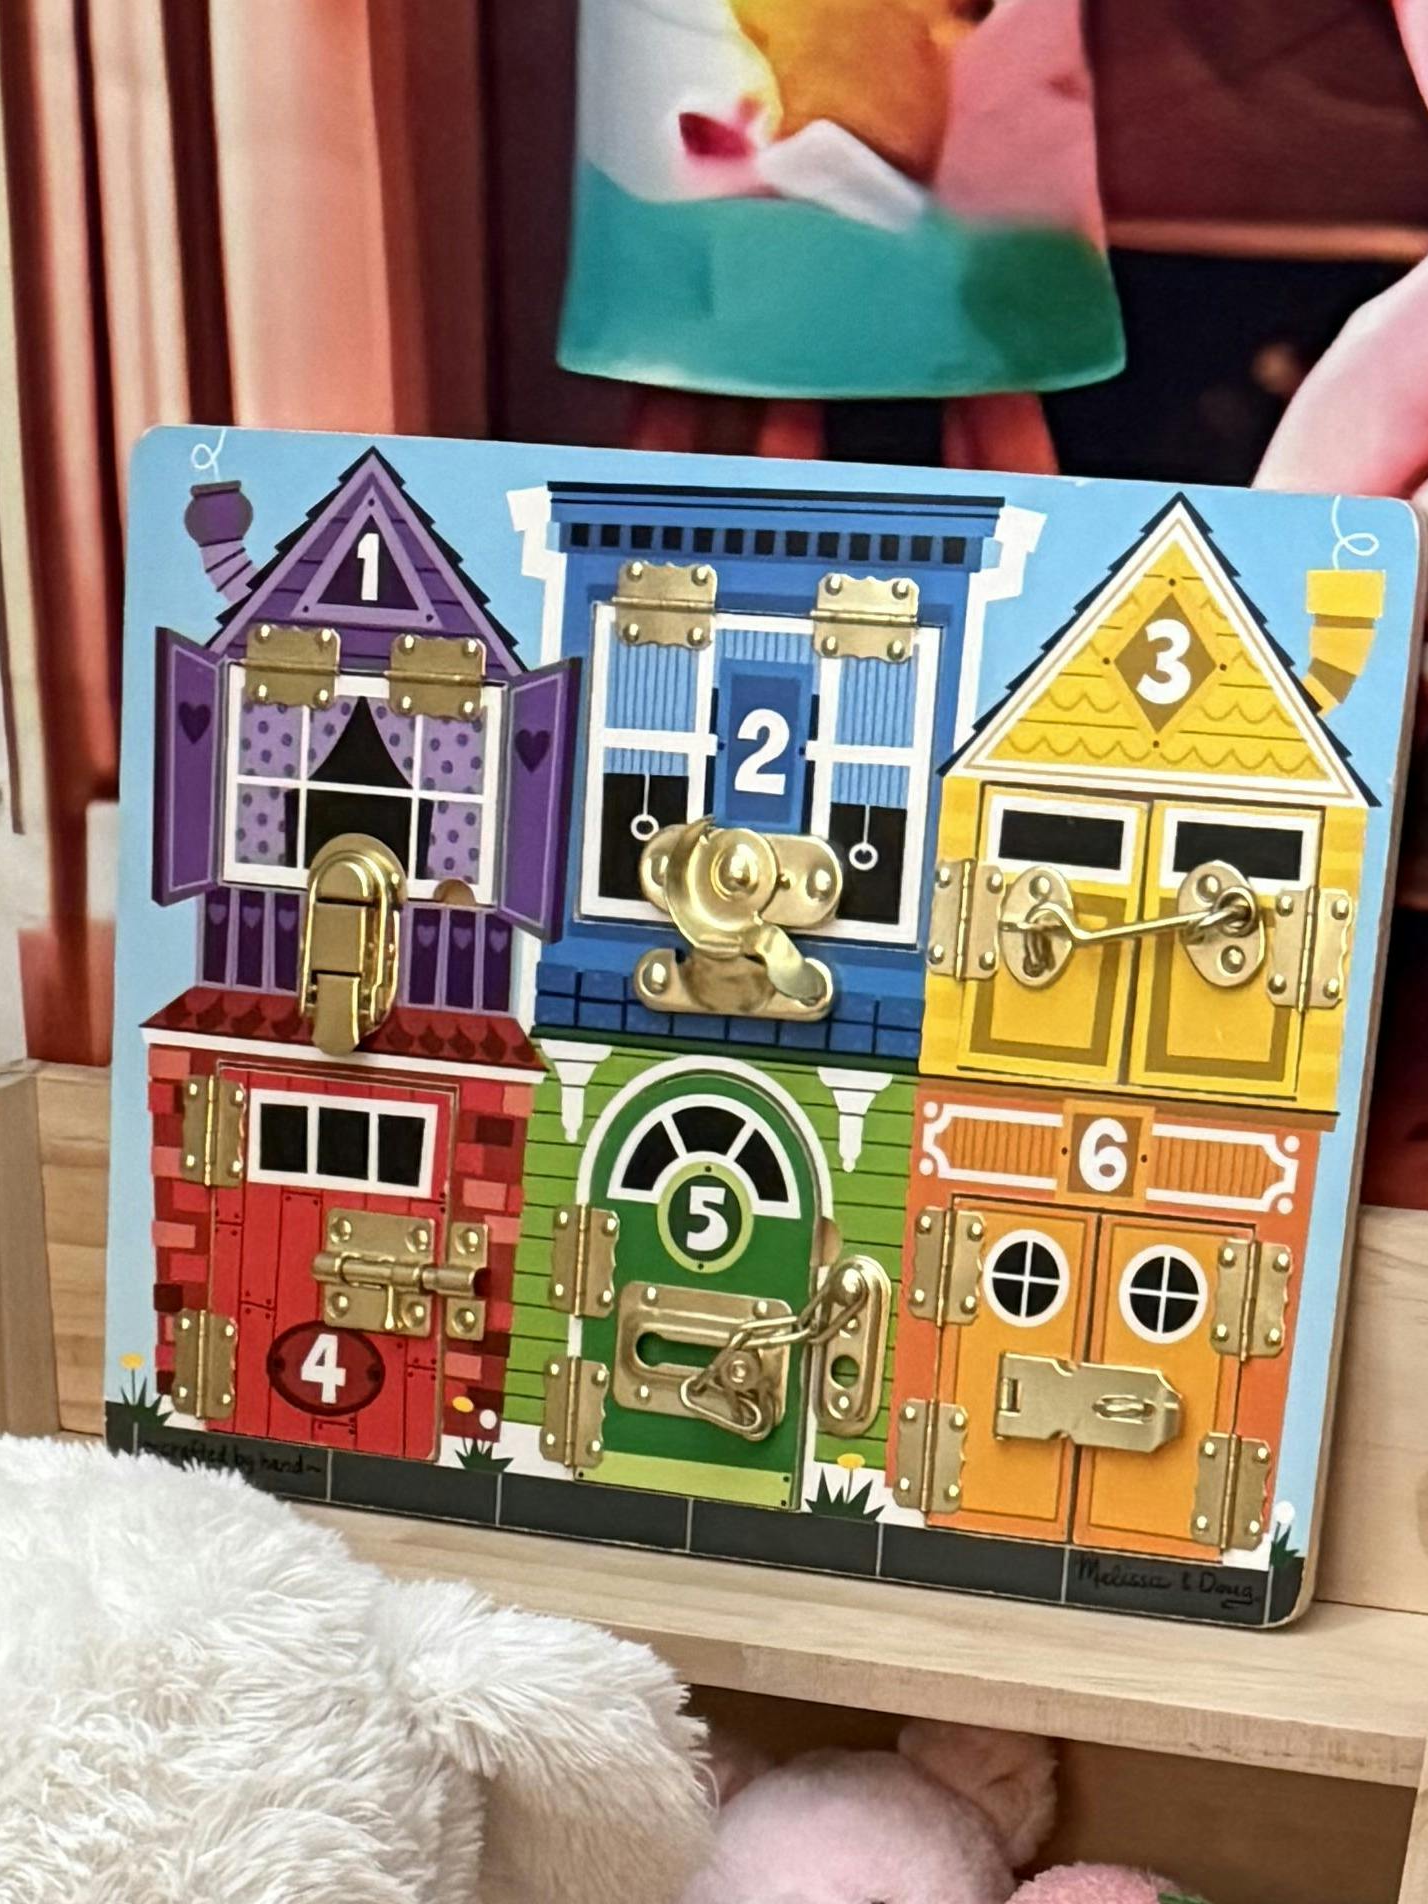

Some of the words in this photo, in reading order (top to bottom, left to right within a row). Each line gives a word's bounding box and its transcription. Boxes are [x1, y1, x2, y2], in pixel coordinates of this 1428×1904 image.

[355, 532, 380, 603] 1
[1137, 622, 1194, 703] 3
[736, 709, 790, 797] 2
[1077, 1115, 1129, 1188] 6
[685, 1185, 729, 1250] 5
[301, 1333, 347, 1403] 4
[1077, 1556, 1170, 1590] Melissa
[1199, 1571, 1254, 1609] Doug
